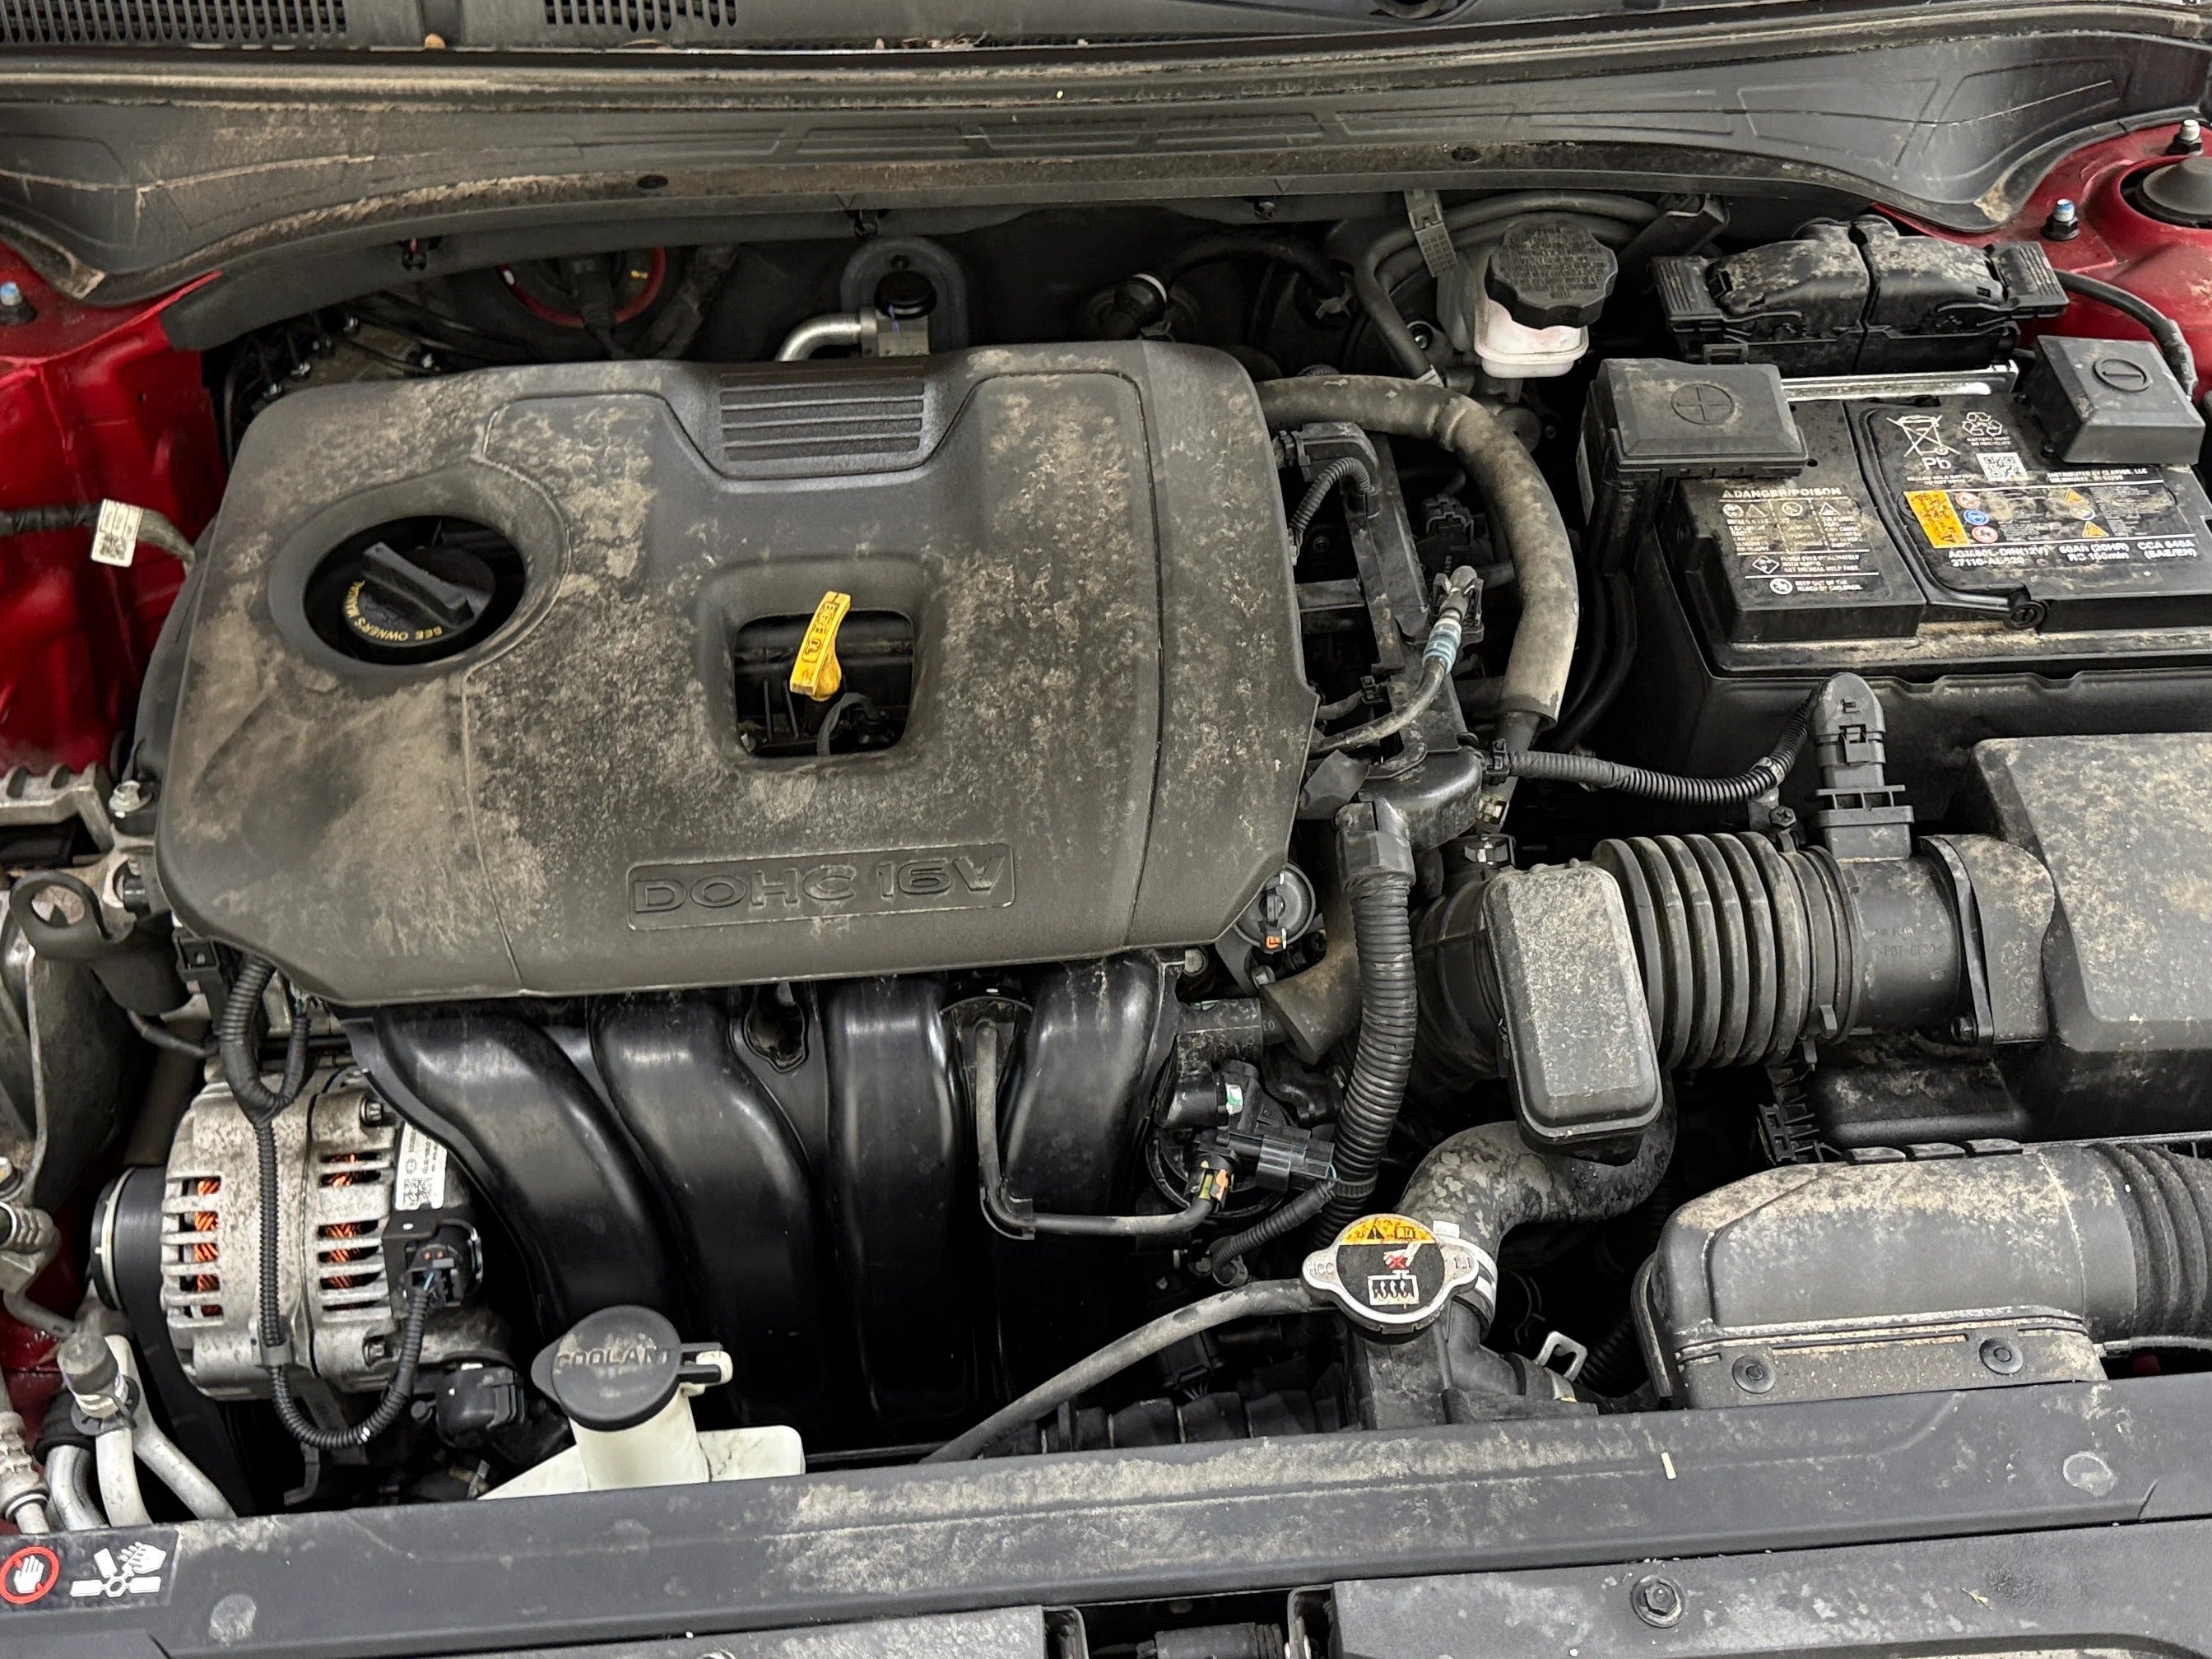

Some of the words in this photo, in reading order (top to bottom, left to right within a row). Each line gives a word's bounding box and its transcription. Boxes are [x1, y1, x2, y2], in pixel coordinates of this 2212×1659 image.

[1922, 457, 1952, 470] Pb
[1733, 487, 1842, 498] DANGER/POISON
[2137, 541, 2164, 550] CCA
[2067, 553, 2086, 561] RC
[415, 625, 443, 641] SEE
[634, 864, 857, 914] DOHC
[877, 855, 1007, 903] 16V
[1308, 1262, 1335, 1276] HCC
